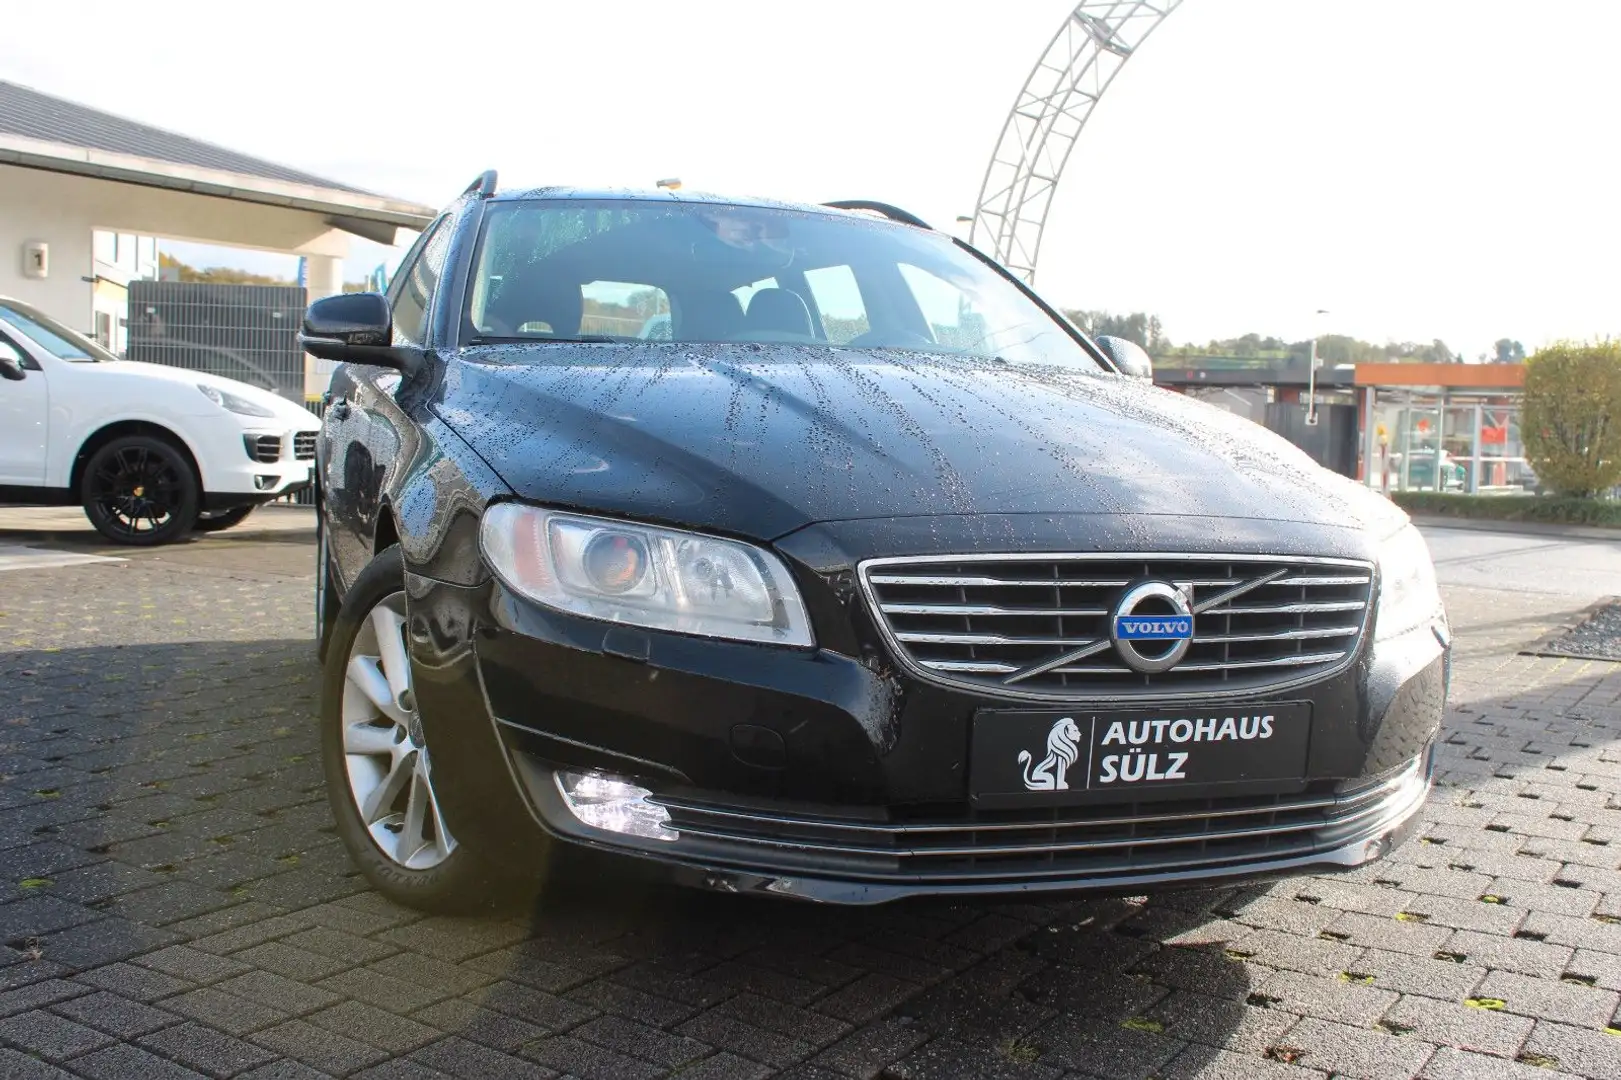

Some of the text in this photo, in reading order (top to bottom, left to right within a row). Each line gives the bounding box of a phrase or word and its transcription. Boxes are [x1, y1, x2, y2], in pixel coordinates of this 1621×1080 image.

[1121, 621, 1189, 634] VOLVO
[1101, 715, 1275, 746] AUTOHAUS
[1100, 748, 1189, 783] SÜLZ
